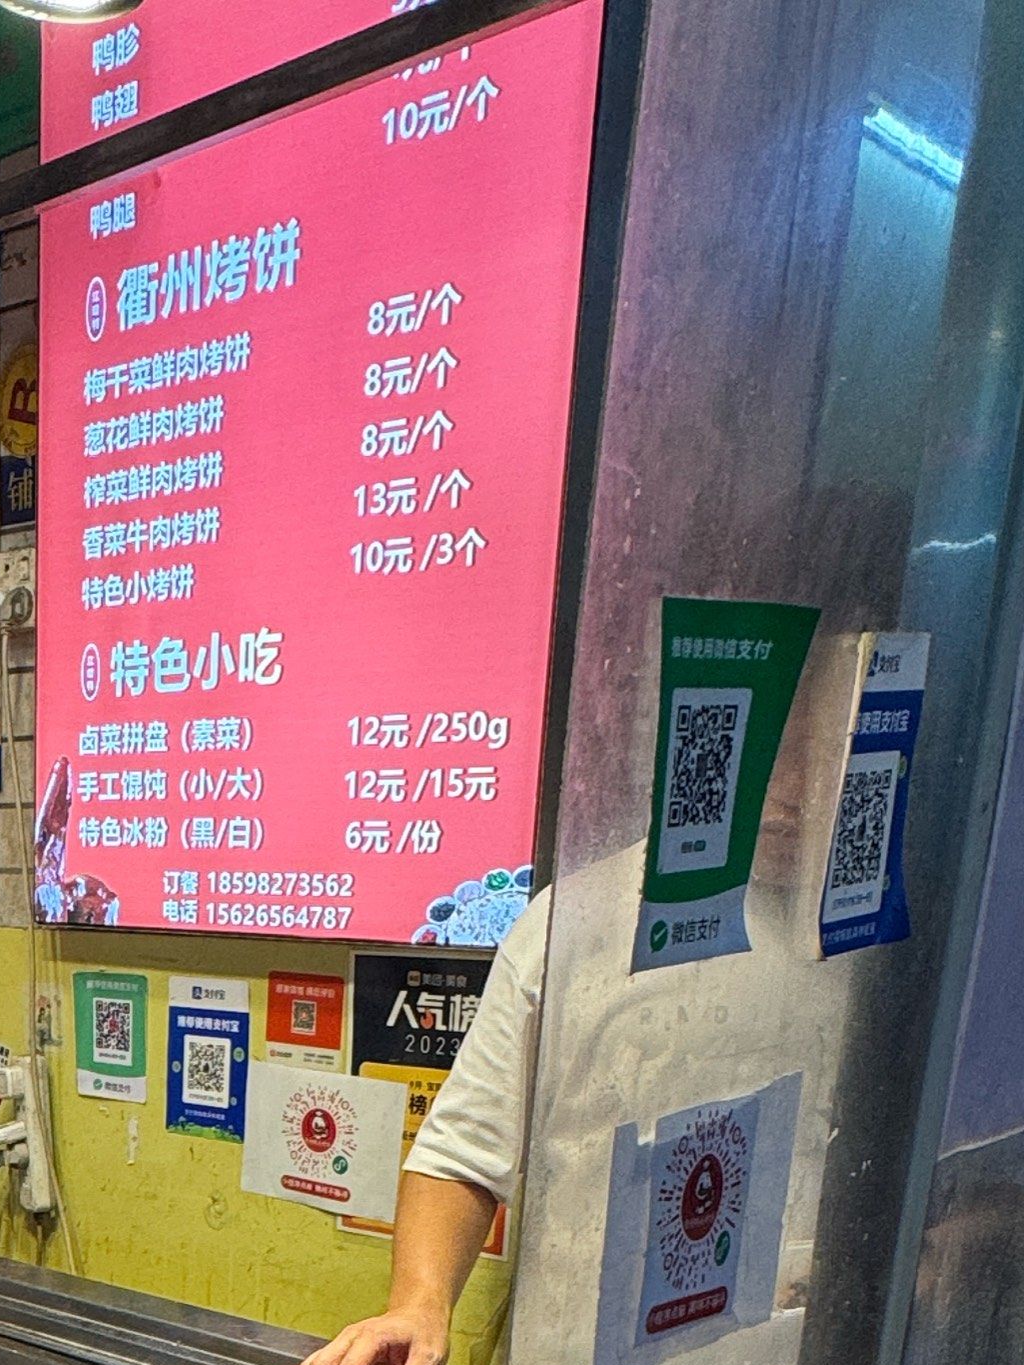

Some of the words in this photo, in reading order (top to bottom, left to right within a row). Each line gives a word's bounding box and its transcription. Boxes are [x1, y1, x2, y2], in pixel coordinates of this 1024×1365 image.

[92, 23, 141, 76] 鸭胗
[91, 80, 139, 130] 鸭翅
[382, 75, 501, 145] 10元/个
[89, 192, 137, 240] 鸭腿
[116, 217, 302, 332] 衢州烤饼
[366, 283, 463, 336] 8元/个
[83, 331, 251, 405] 梅干菜鲜肉烤饼
[363, 347, 459, 399] 8元/个
[83, 395, 225, 459] 葱花鲜肉烤饼
[360, 410, 455, 459] 8元/个
[83, 450, 224, 510] 榨菜鲜肉烤饼
[82, 507, 221, 561] 香菜牛肉烤饼
[81, 564, 195, 611] 特色小烤饼
[110, 626, 284, 698] 特色小吃
[162, 870, 199, 895] 订餐
[206, 871, 355, 897] 18598273562
[162, 899, 199, 924] 电话
[205, 902, 353, 929] 15626564787
[670, 914, 722, 945] 微信支付
[404, 1033, 463, 1056] 2023
